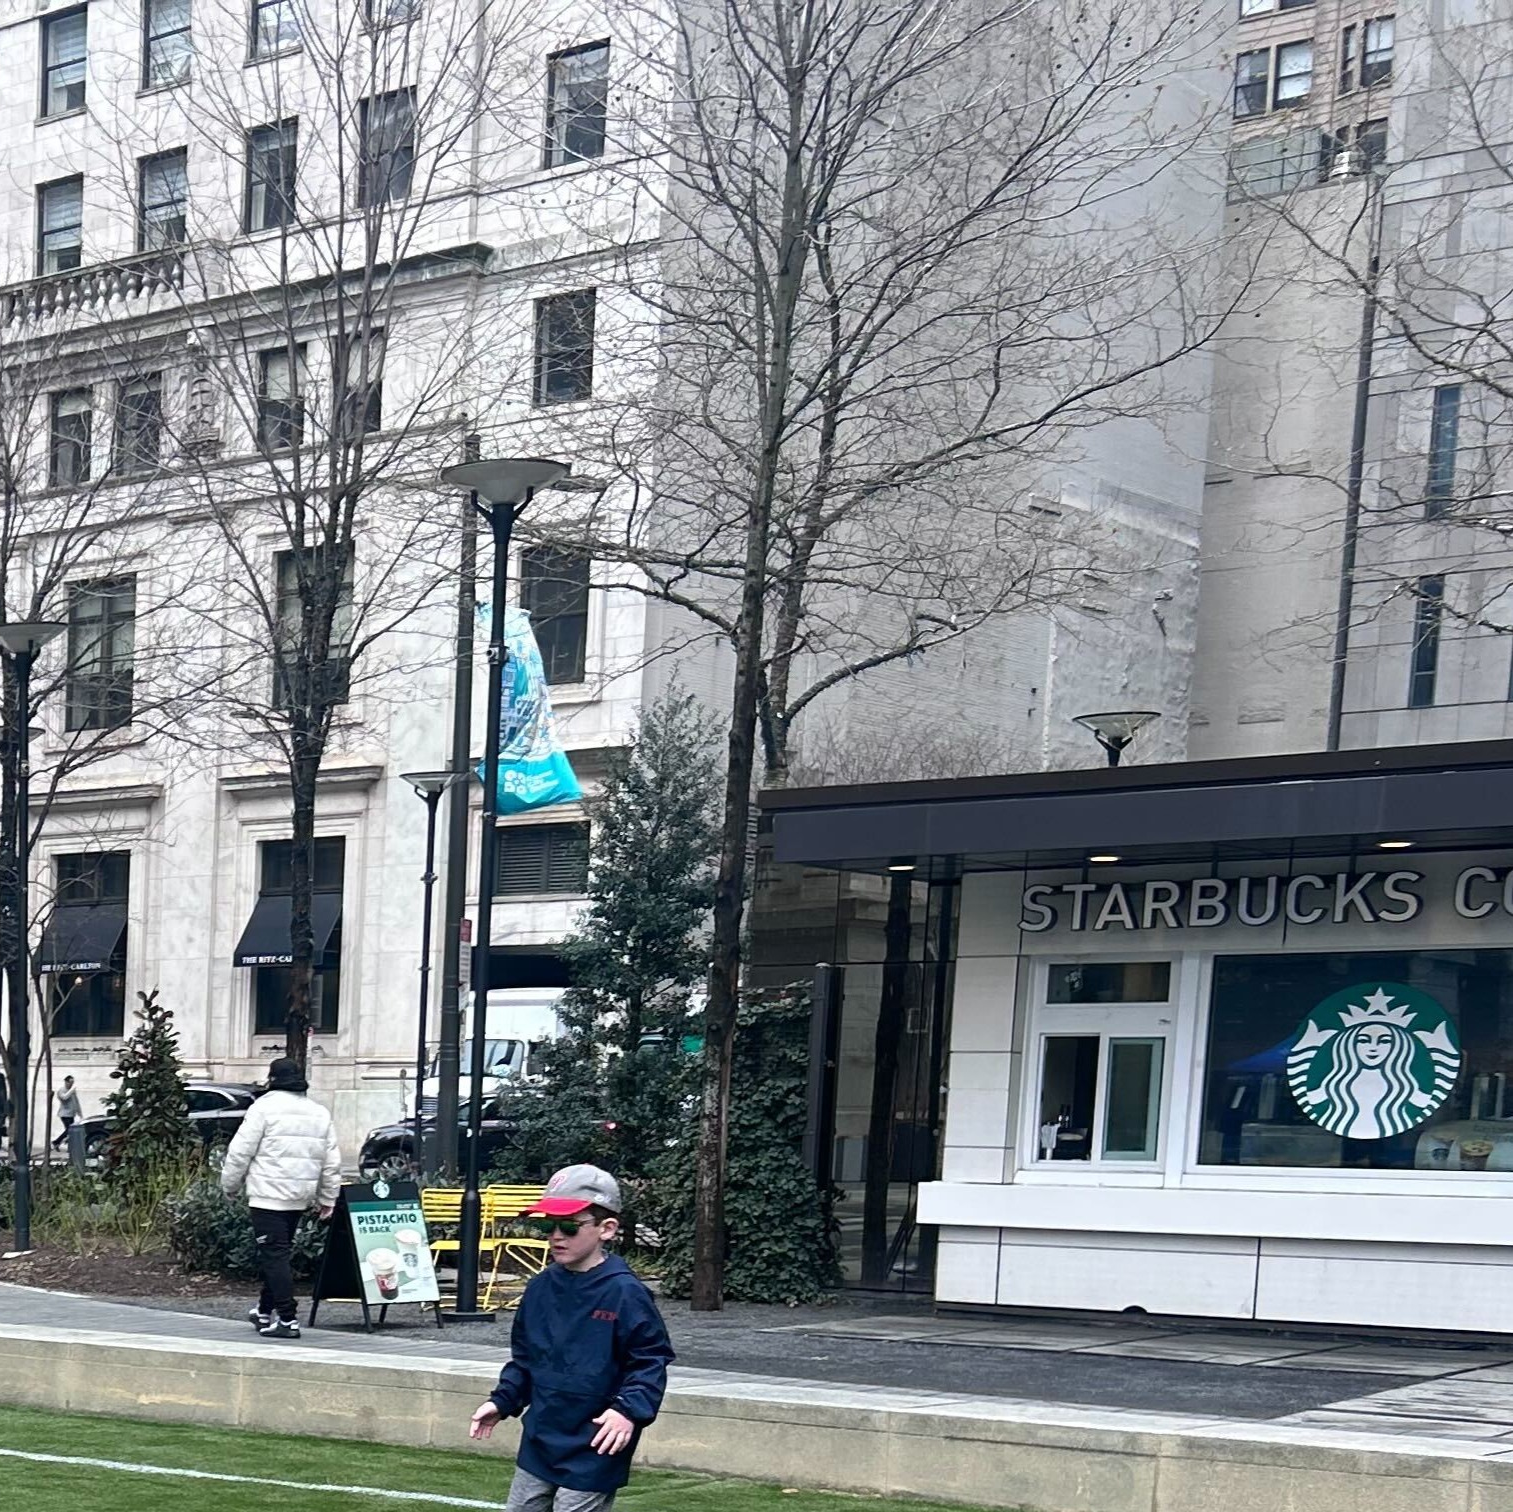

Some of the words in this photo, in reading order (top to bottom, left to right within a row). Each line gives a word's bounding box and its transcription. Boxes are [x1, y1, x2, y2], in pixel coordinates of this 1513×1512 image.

[1019, 871, 1422, 931] STARBUCKS
[1454, 866, 1513, 918] C
[357, 1213, 417, 1225] PISTACHIO
[369, 1225, 391, 1233] BACK
